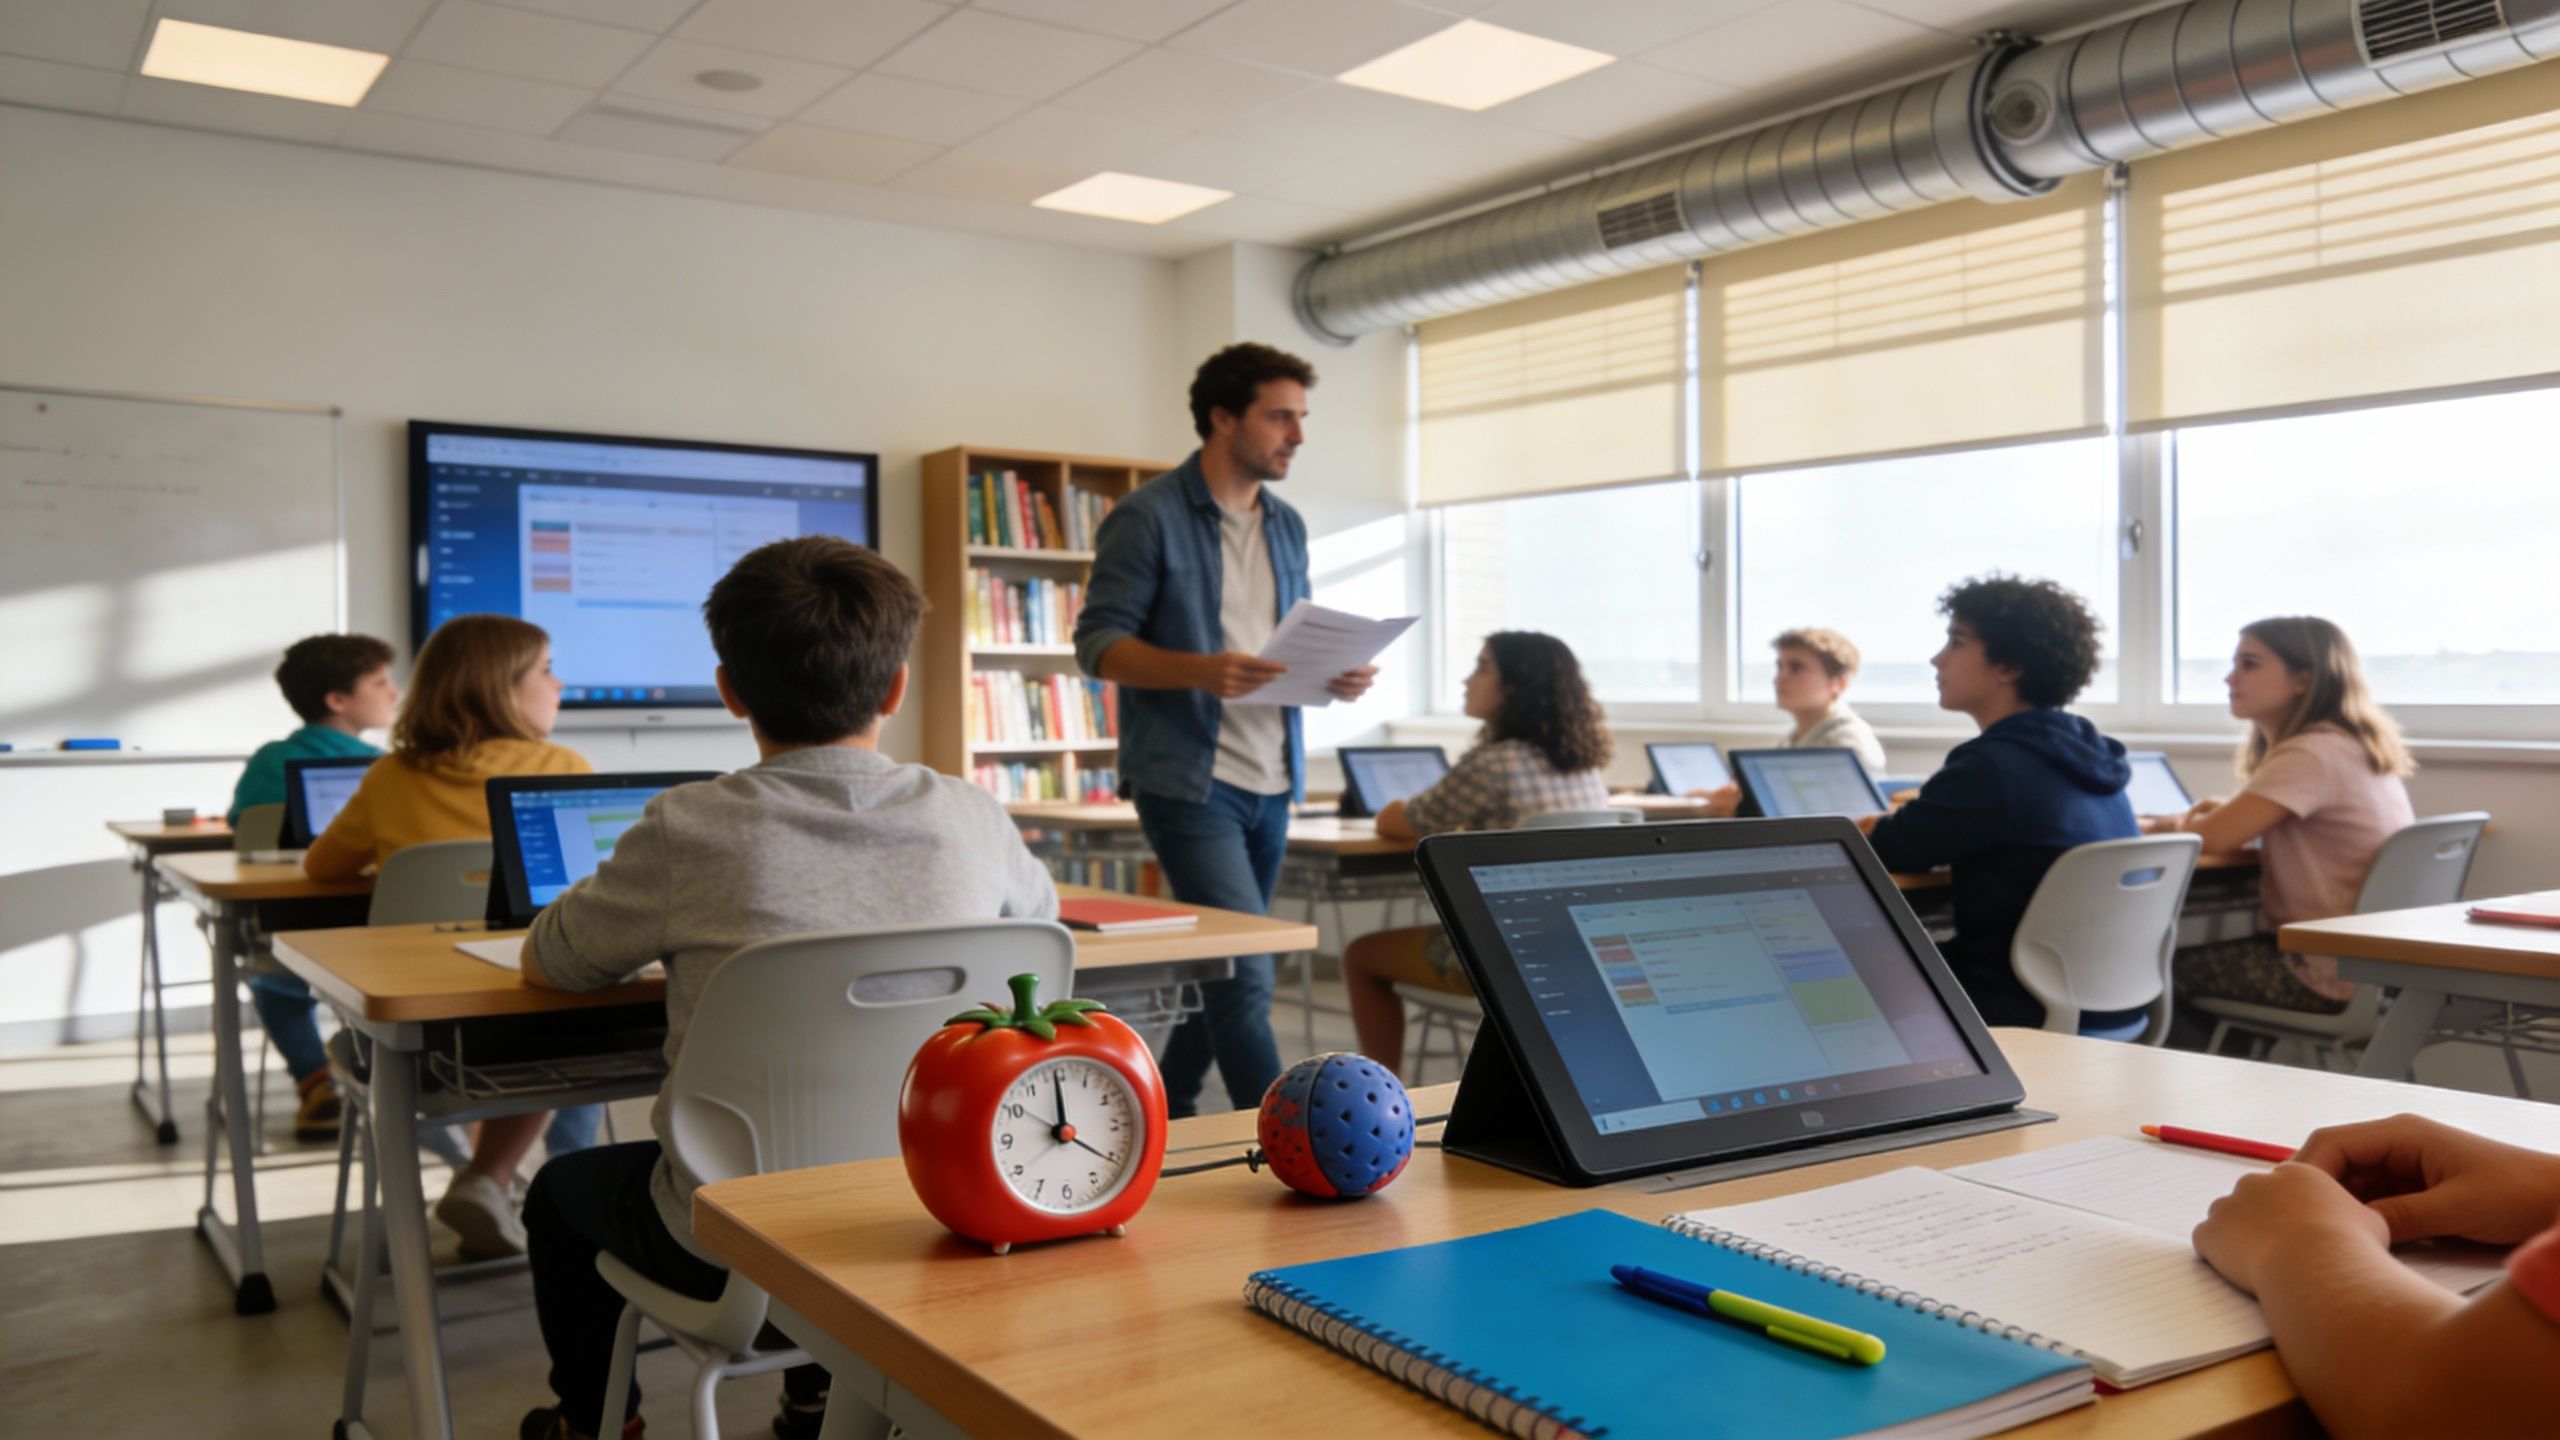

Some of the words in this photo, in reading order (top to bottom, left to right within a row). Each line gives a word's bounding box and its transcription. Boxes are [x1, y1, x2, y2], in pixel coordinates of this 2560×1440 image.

[1002, 1103, 1024, 1119] 10
[1001, 1132, 1013, 1150] 9
[1062, 1183, 1073, 1199] 6
